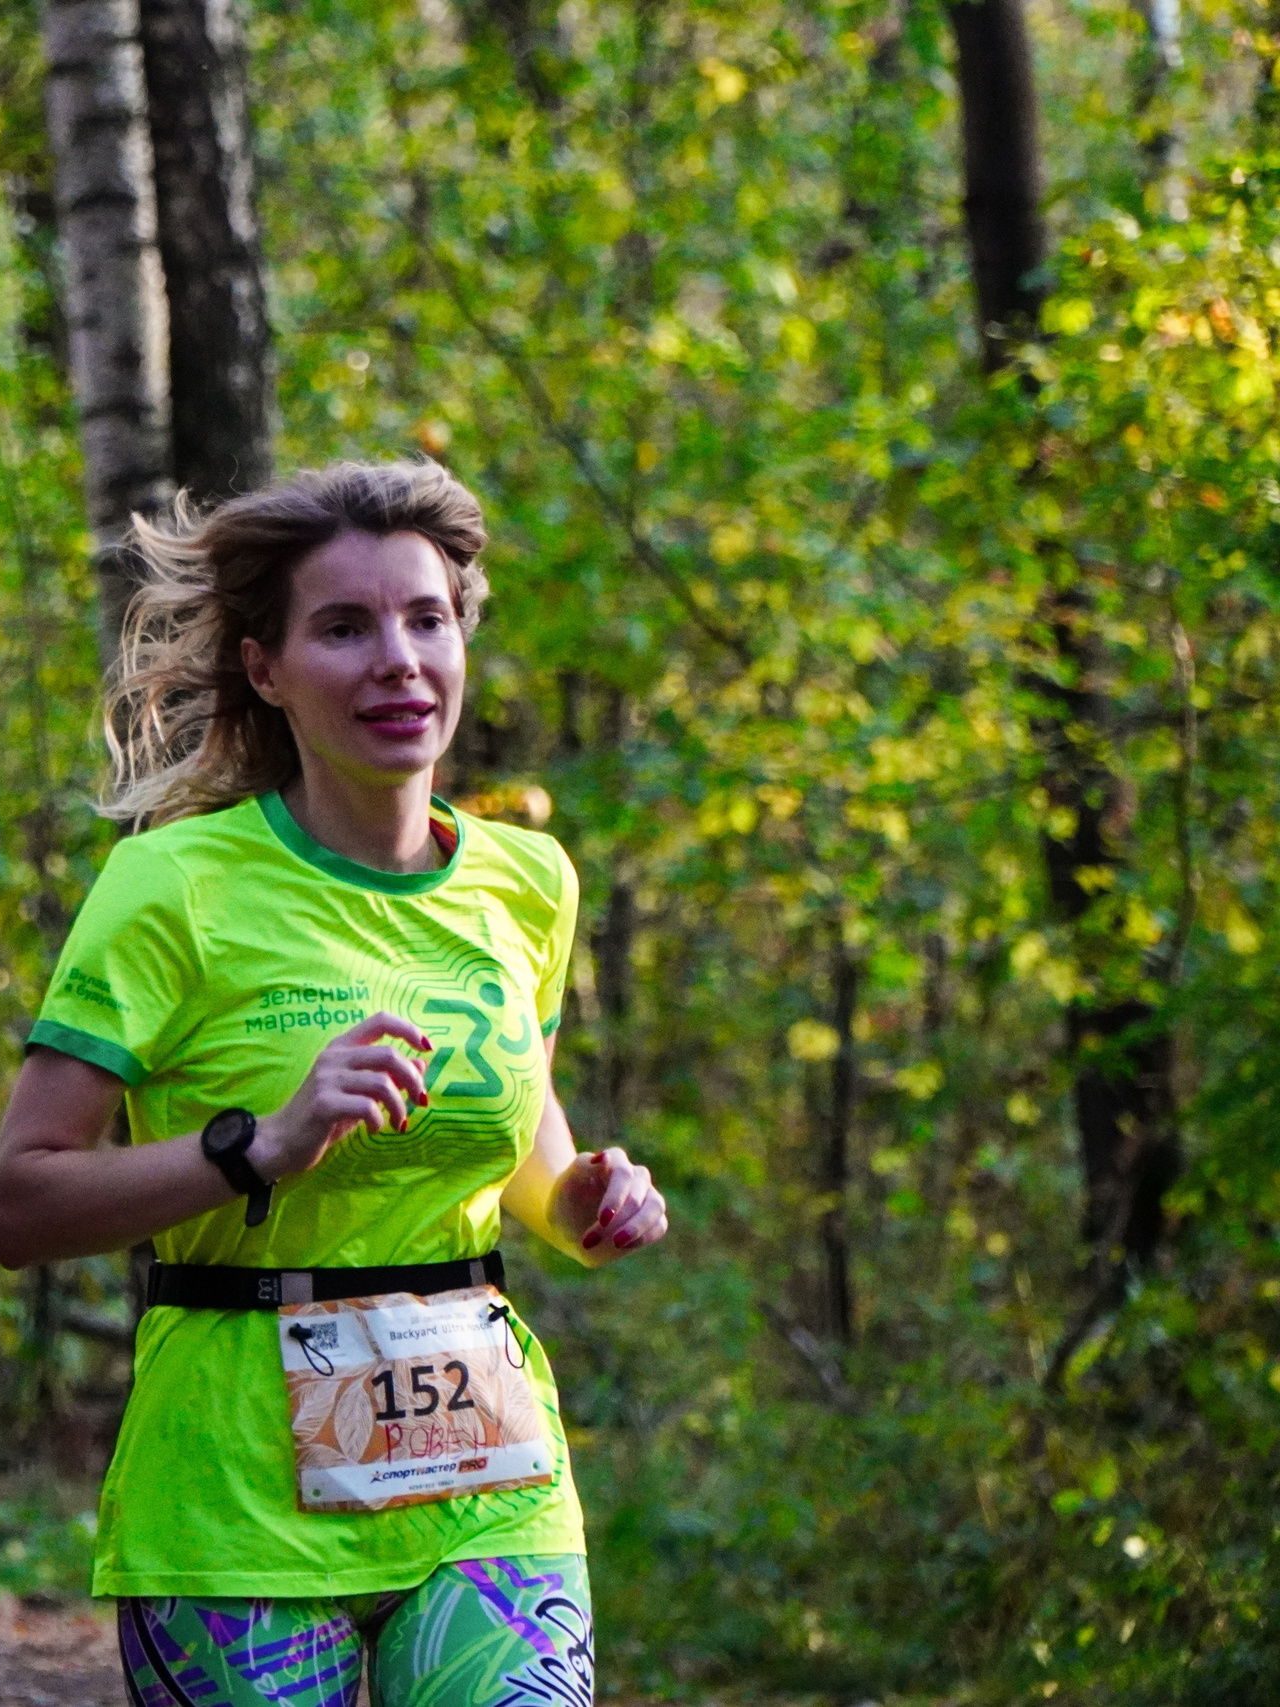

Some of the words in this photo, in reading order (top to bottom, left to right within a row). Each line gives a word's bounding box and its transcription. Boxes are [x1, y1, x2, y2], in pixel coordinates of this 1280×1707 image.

[260, 980, 370, 1009] зелёный
[245, 1004, 365, 1034] марафон
[389, 1325, 438, 1341] Backyard
[441, 1322, 464, 1335] Ultra
[370, 1359, 475, 1421] 152
